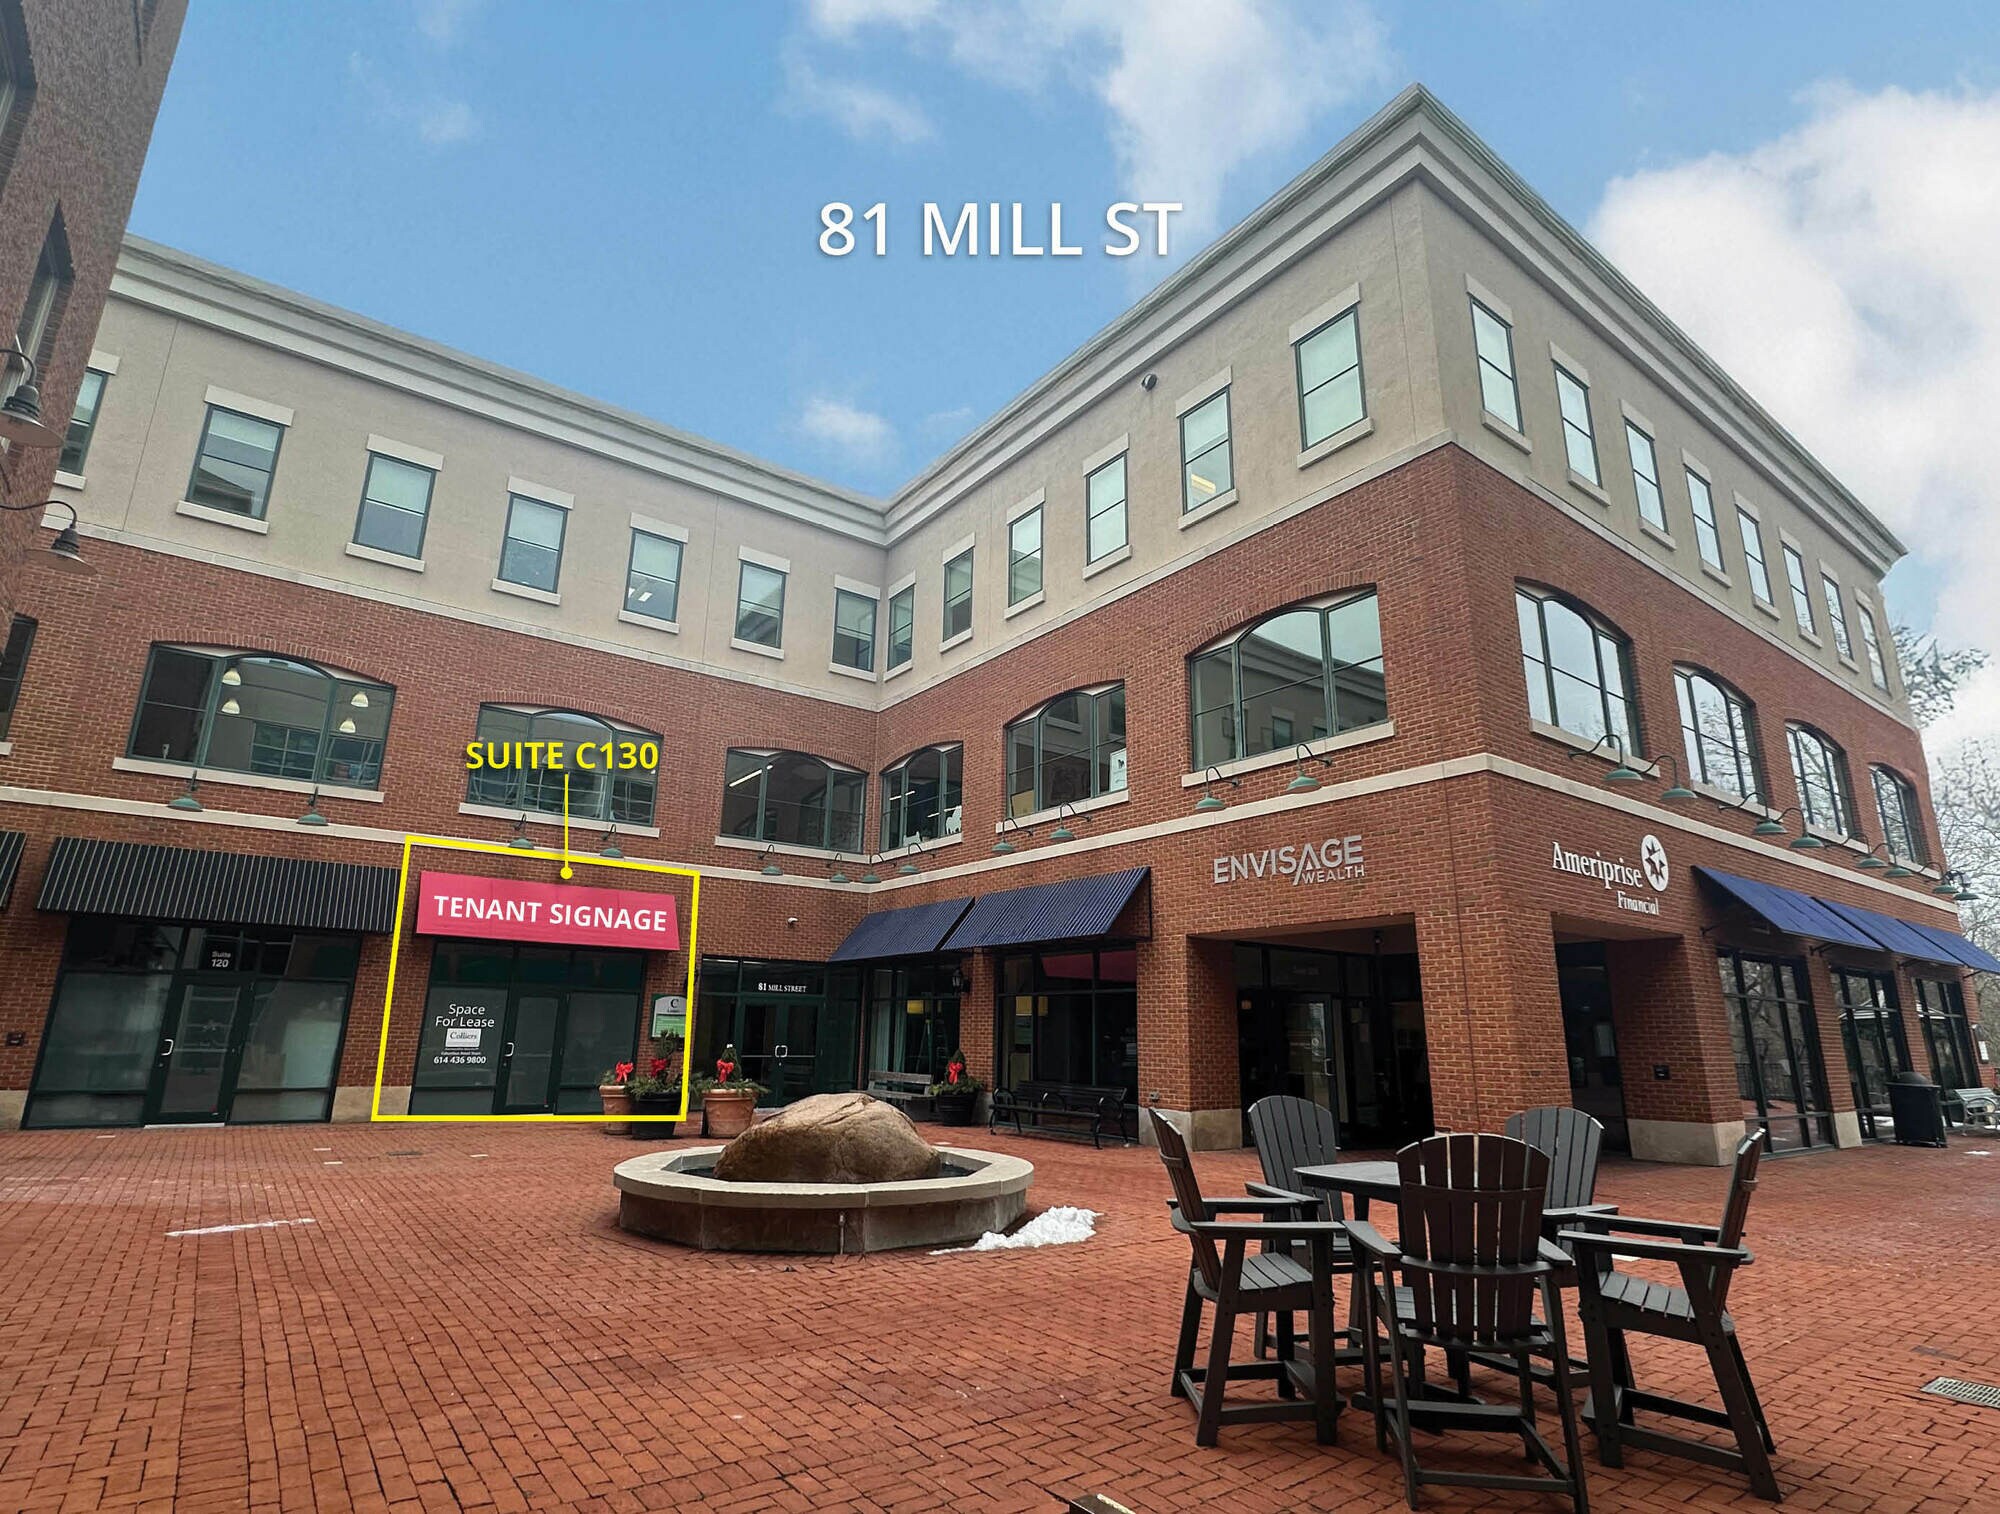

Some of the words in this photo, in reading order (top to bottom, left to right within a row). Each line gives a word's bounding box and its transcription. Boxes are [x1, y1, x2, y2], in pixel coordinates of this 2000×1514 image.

[1213, 834, 1364, 886] ENVISAGE
[1551, 840, 1644, 890] Ameriprise
[1301, 863, 1366, 885] WEALTH
[1616, 889, 1661, 916] Financial
[211, 959, 229, 968] 120
[758, 982, 767, 991] 81
[783, 985, 807, 993] STREET
[448, 1003, 486, 1018] Space
[670, 998, 680, 1009] C
[435, 1015, 457, 1027] For
[460, 1016, 495, 1028] Lease
[433, 1056, 449, 1064] 614
[449, 1056, 465, 1064] 436
[466, 1056, 487, 1064] 9800
